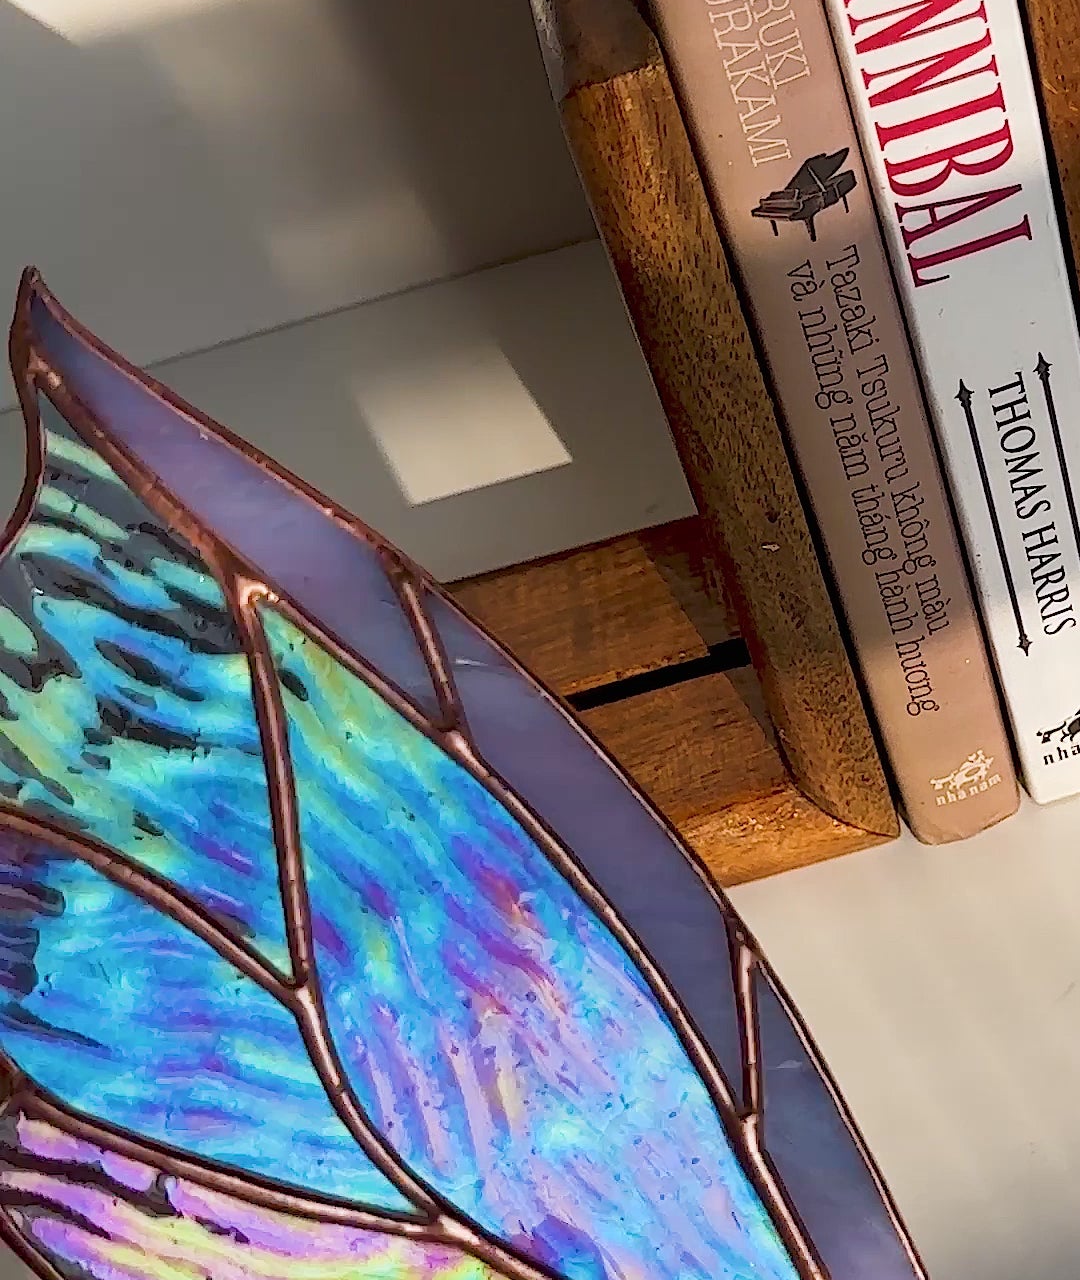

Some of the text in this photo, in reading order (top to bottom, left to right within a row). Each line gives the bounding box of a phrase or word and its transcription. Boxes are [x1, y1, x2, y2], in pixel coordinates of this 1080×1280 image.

[787, 259, 825, 302] và
[798, 306, 853, 409] những
[825, 243, 952, 636] Tazaki Tsukuru không màu
[829, 413, 870, 481] năm
[851, 483, 898, 566] tháng
[987, 371, 1077, 636] THOMAS HARRIS
[874, 567, 919, 635] hành
[968, 773, 1002, 797] nam
